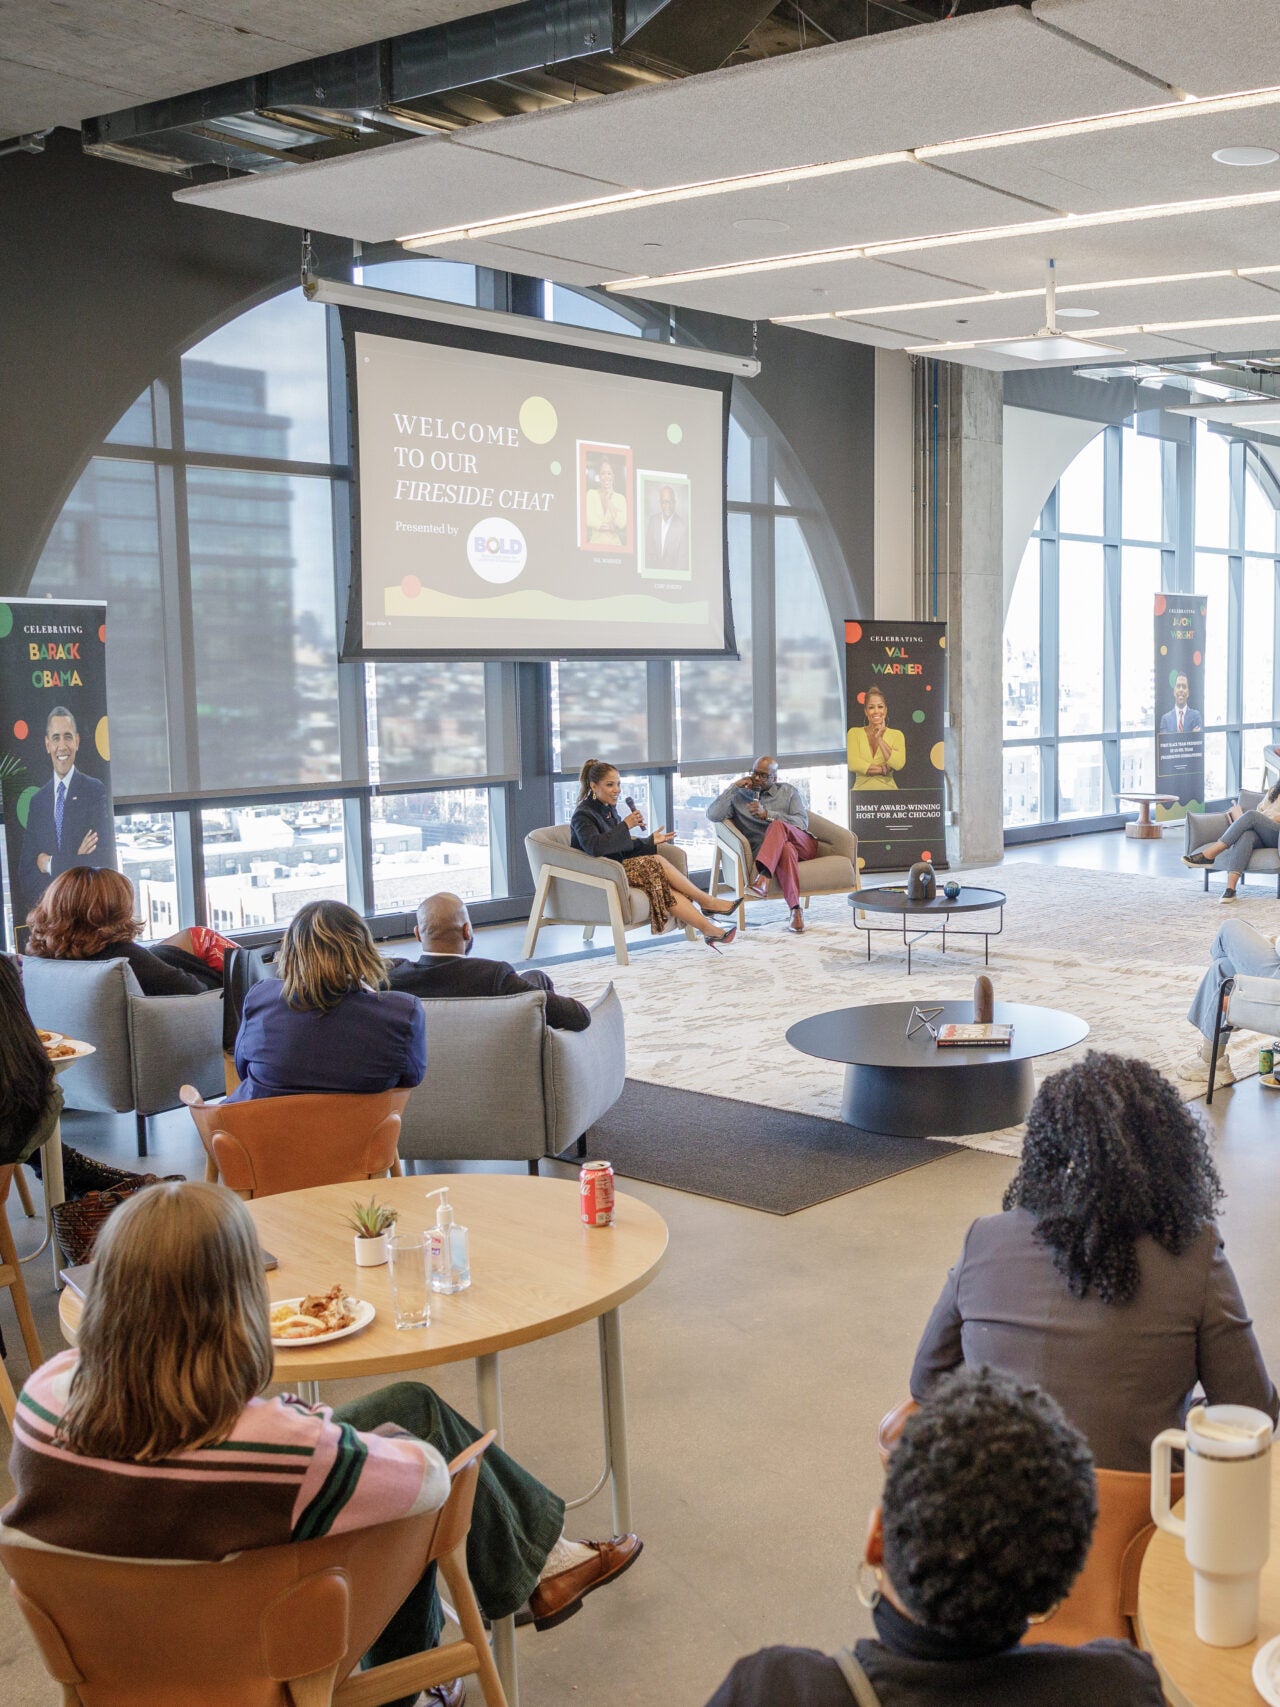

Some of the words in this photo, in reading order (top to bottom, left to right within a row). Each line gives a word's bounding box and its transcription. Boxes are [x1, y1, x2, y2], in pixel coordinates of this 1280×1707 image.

[393, 413, 519, 447] WELCOME
[394, 446, 424, 469] TO
[430, 450, 479, 474] OUR
[394, 479, 494, 507] FIRESIDE
[498, 489, 554, 512] CHAT
[395, 520, 445, 534] Presented
[447, 523, 459, 536] by
[474, 536, 523, 555] BOLD
[23, 625, 83, 634] CELEBRATING
[870, 635, 923, 643] CELEBRATING
[29, 642, 81, 660] BARACK
[884, 646, 909, 658] VAL
[871, 663, 923, 675] WARNER
[31, 669, 83, 689] OBAMA
[855, 804, 879, 812] EMMY
[880, 803, 941, 811] AWARD-WINNING
